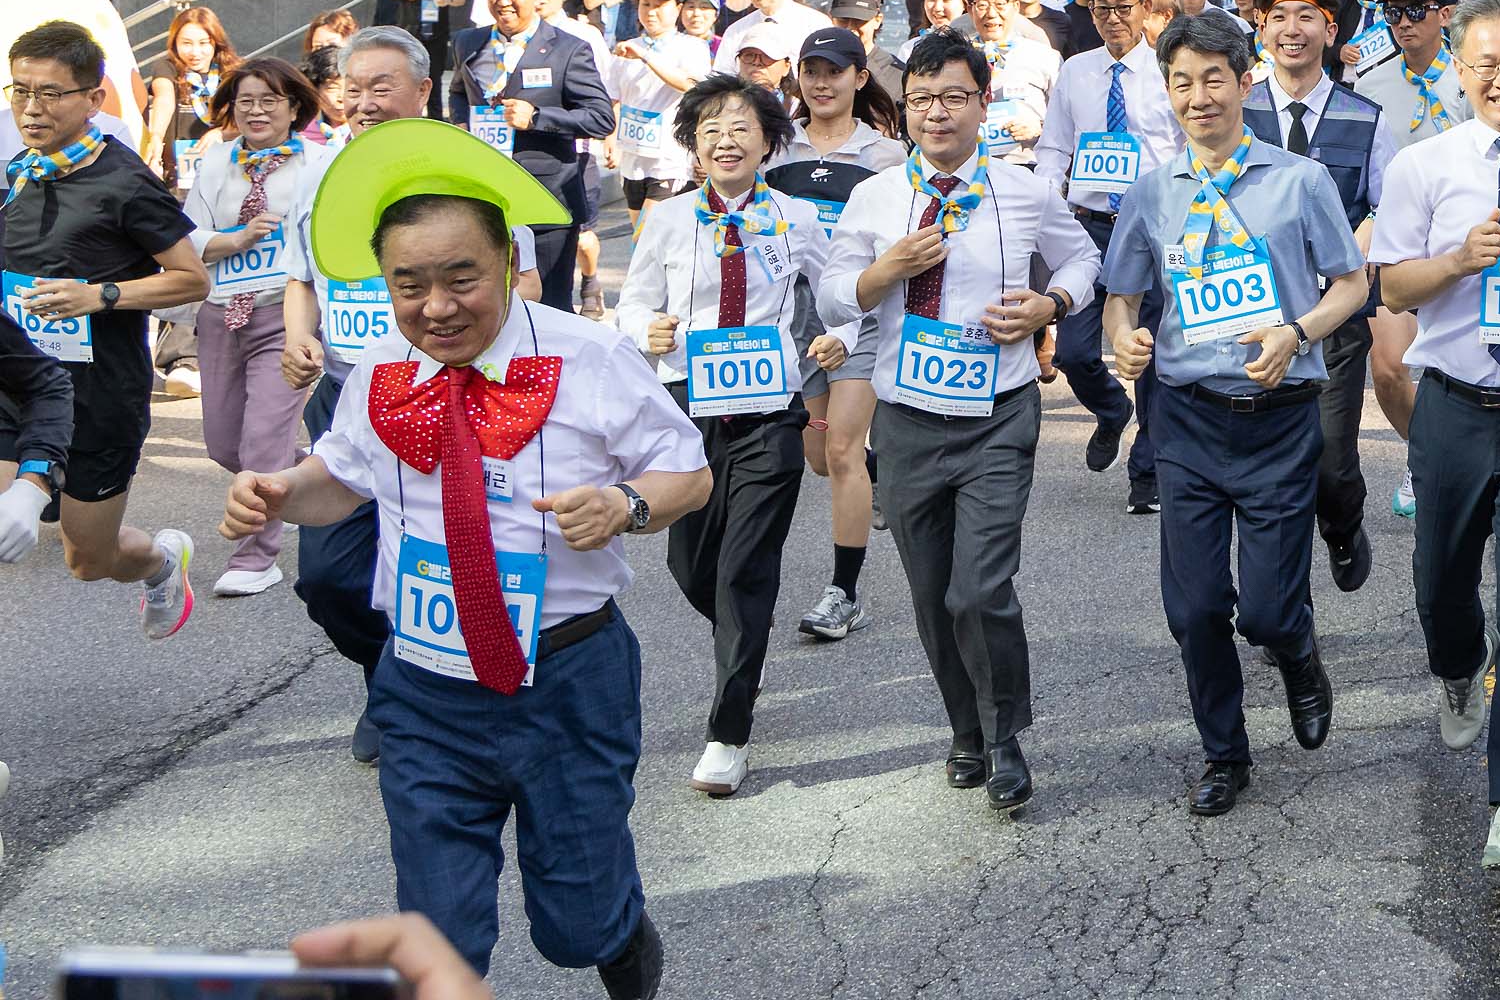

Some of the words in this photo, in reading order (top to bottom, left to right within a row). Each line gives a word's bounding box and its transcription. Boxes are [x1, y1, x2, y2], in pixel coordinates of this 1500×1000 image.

[1359, 34, 1387, 58] 1122
[624, 121, 656, 142] 1806
[1083, 154, 1129, 176] 1001
[223, 246, 277, 276] 1007
[1185, 273, 1266, 315] 1003
[332, 309, 389, 338] 1005
[761, 338, 770, 349] 런
[703, 357, 774, 389] 1010
[911, 351, 988, 390] 1023
[506, 573, 521, 588] 런
[410, 586, 523, 638] 104
